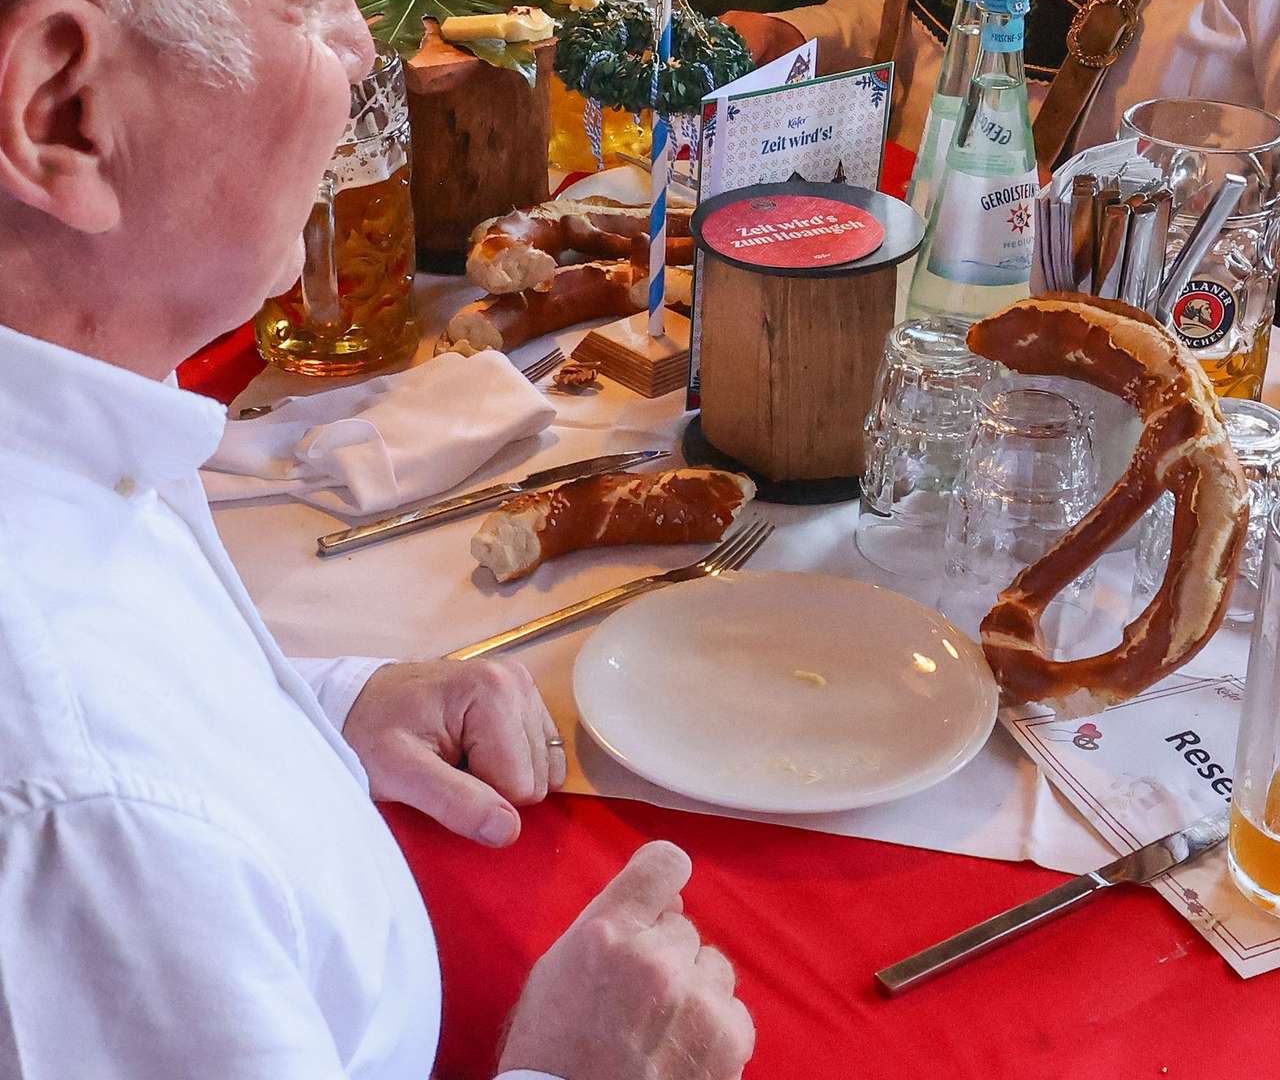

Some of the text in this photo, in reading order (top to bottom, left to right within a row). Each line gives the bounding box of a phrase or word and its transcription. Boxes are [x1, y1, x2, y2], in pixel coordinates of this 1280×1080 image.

[761, 125, 833, 155] Zeit wird's!
[730, 220, 865, 248] zum Hoamgeh
[736, 214, 838, 237] Zeit wird's
[1003, 237, 1034, 249] MEDIU
[1164, 730, 1233, 803] Rese
